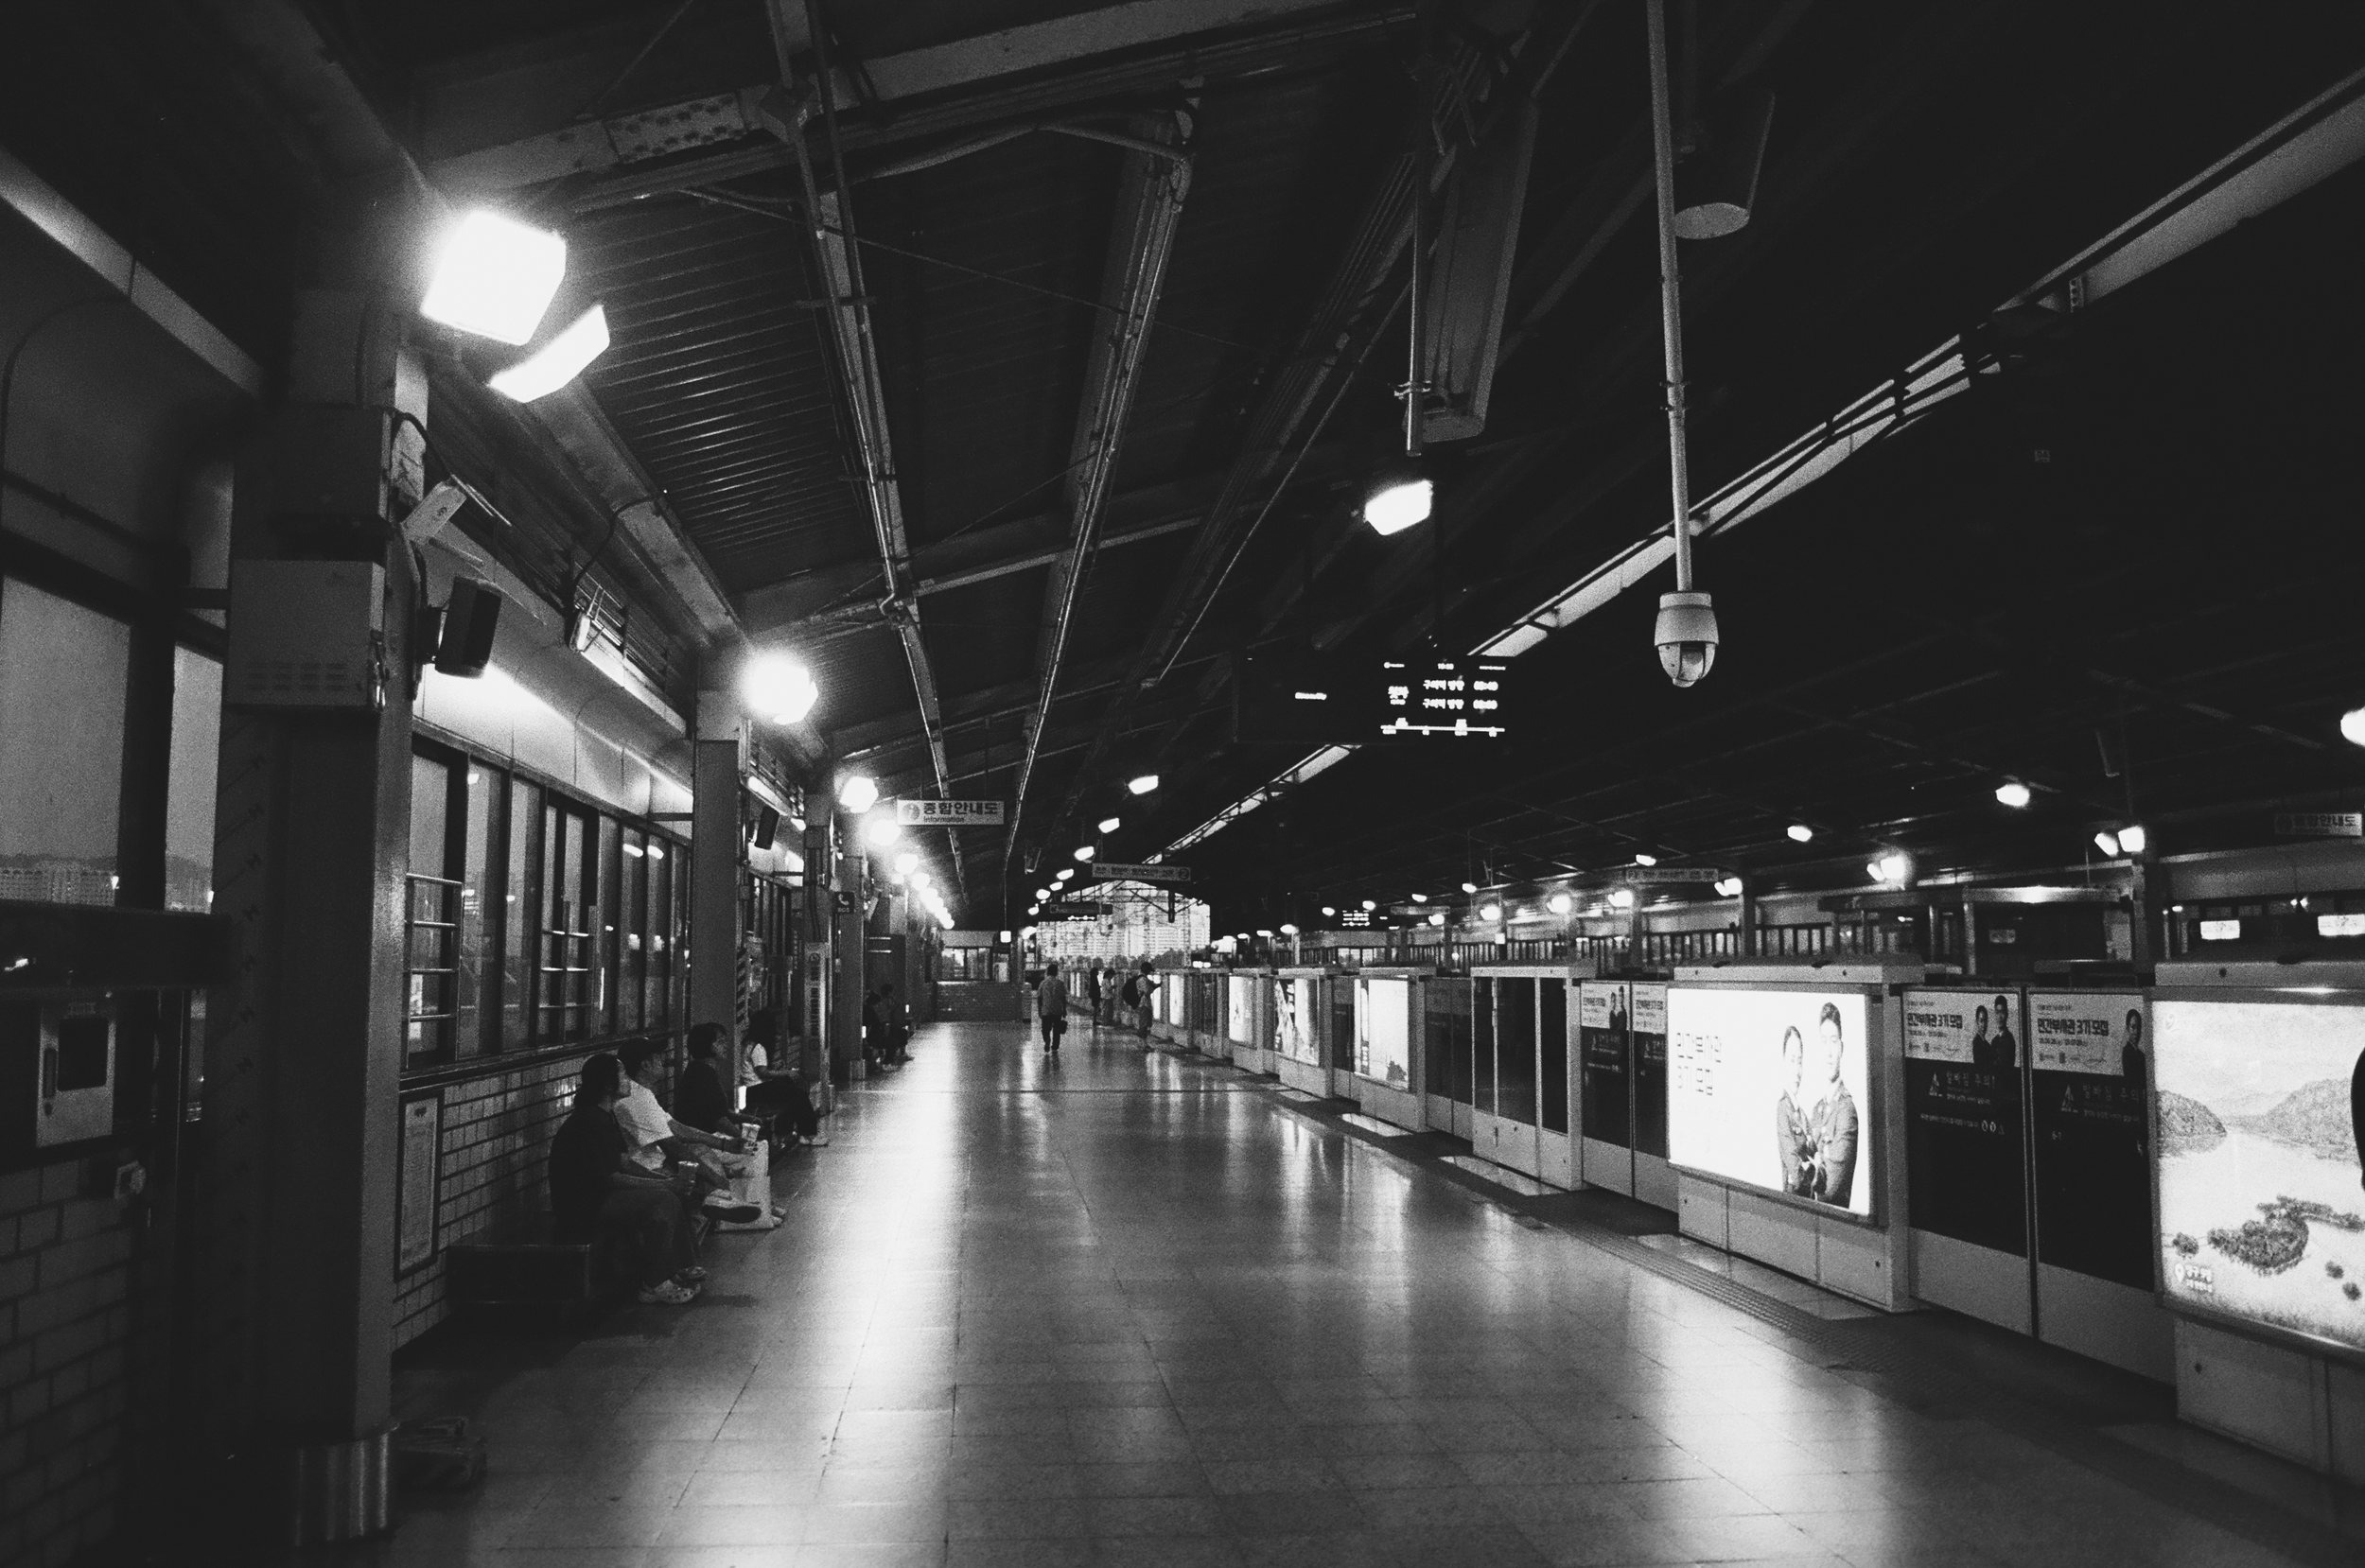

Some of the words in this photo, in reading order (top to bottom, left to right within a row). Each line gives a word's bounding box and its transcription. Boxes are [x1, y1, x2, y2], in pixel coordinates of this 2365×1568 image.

[924, 802, 998, 815] 종합안내도
[924, 815, 965, 824] Information
[1675, 1032, 1723, 1064] 민간부사관
[1676, 1065, 1692, 1092] 3기
[1695, 1067, 1713, 1096] 모집
